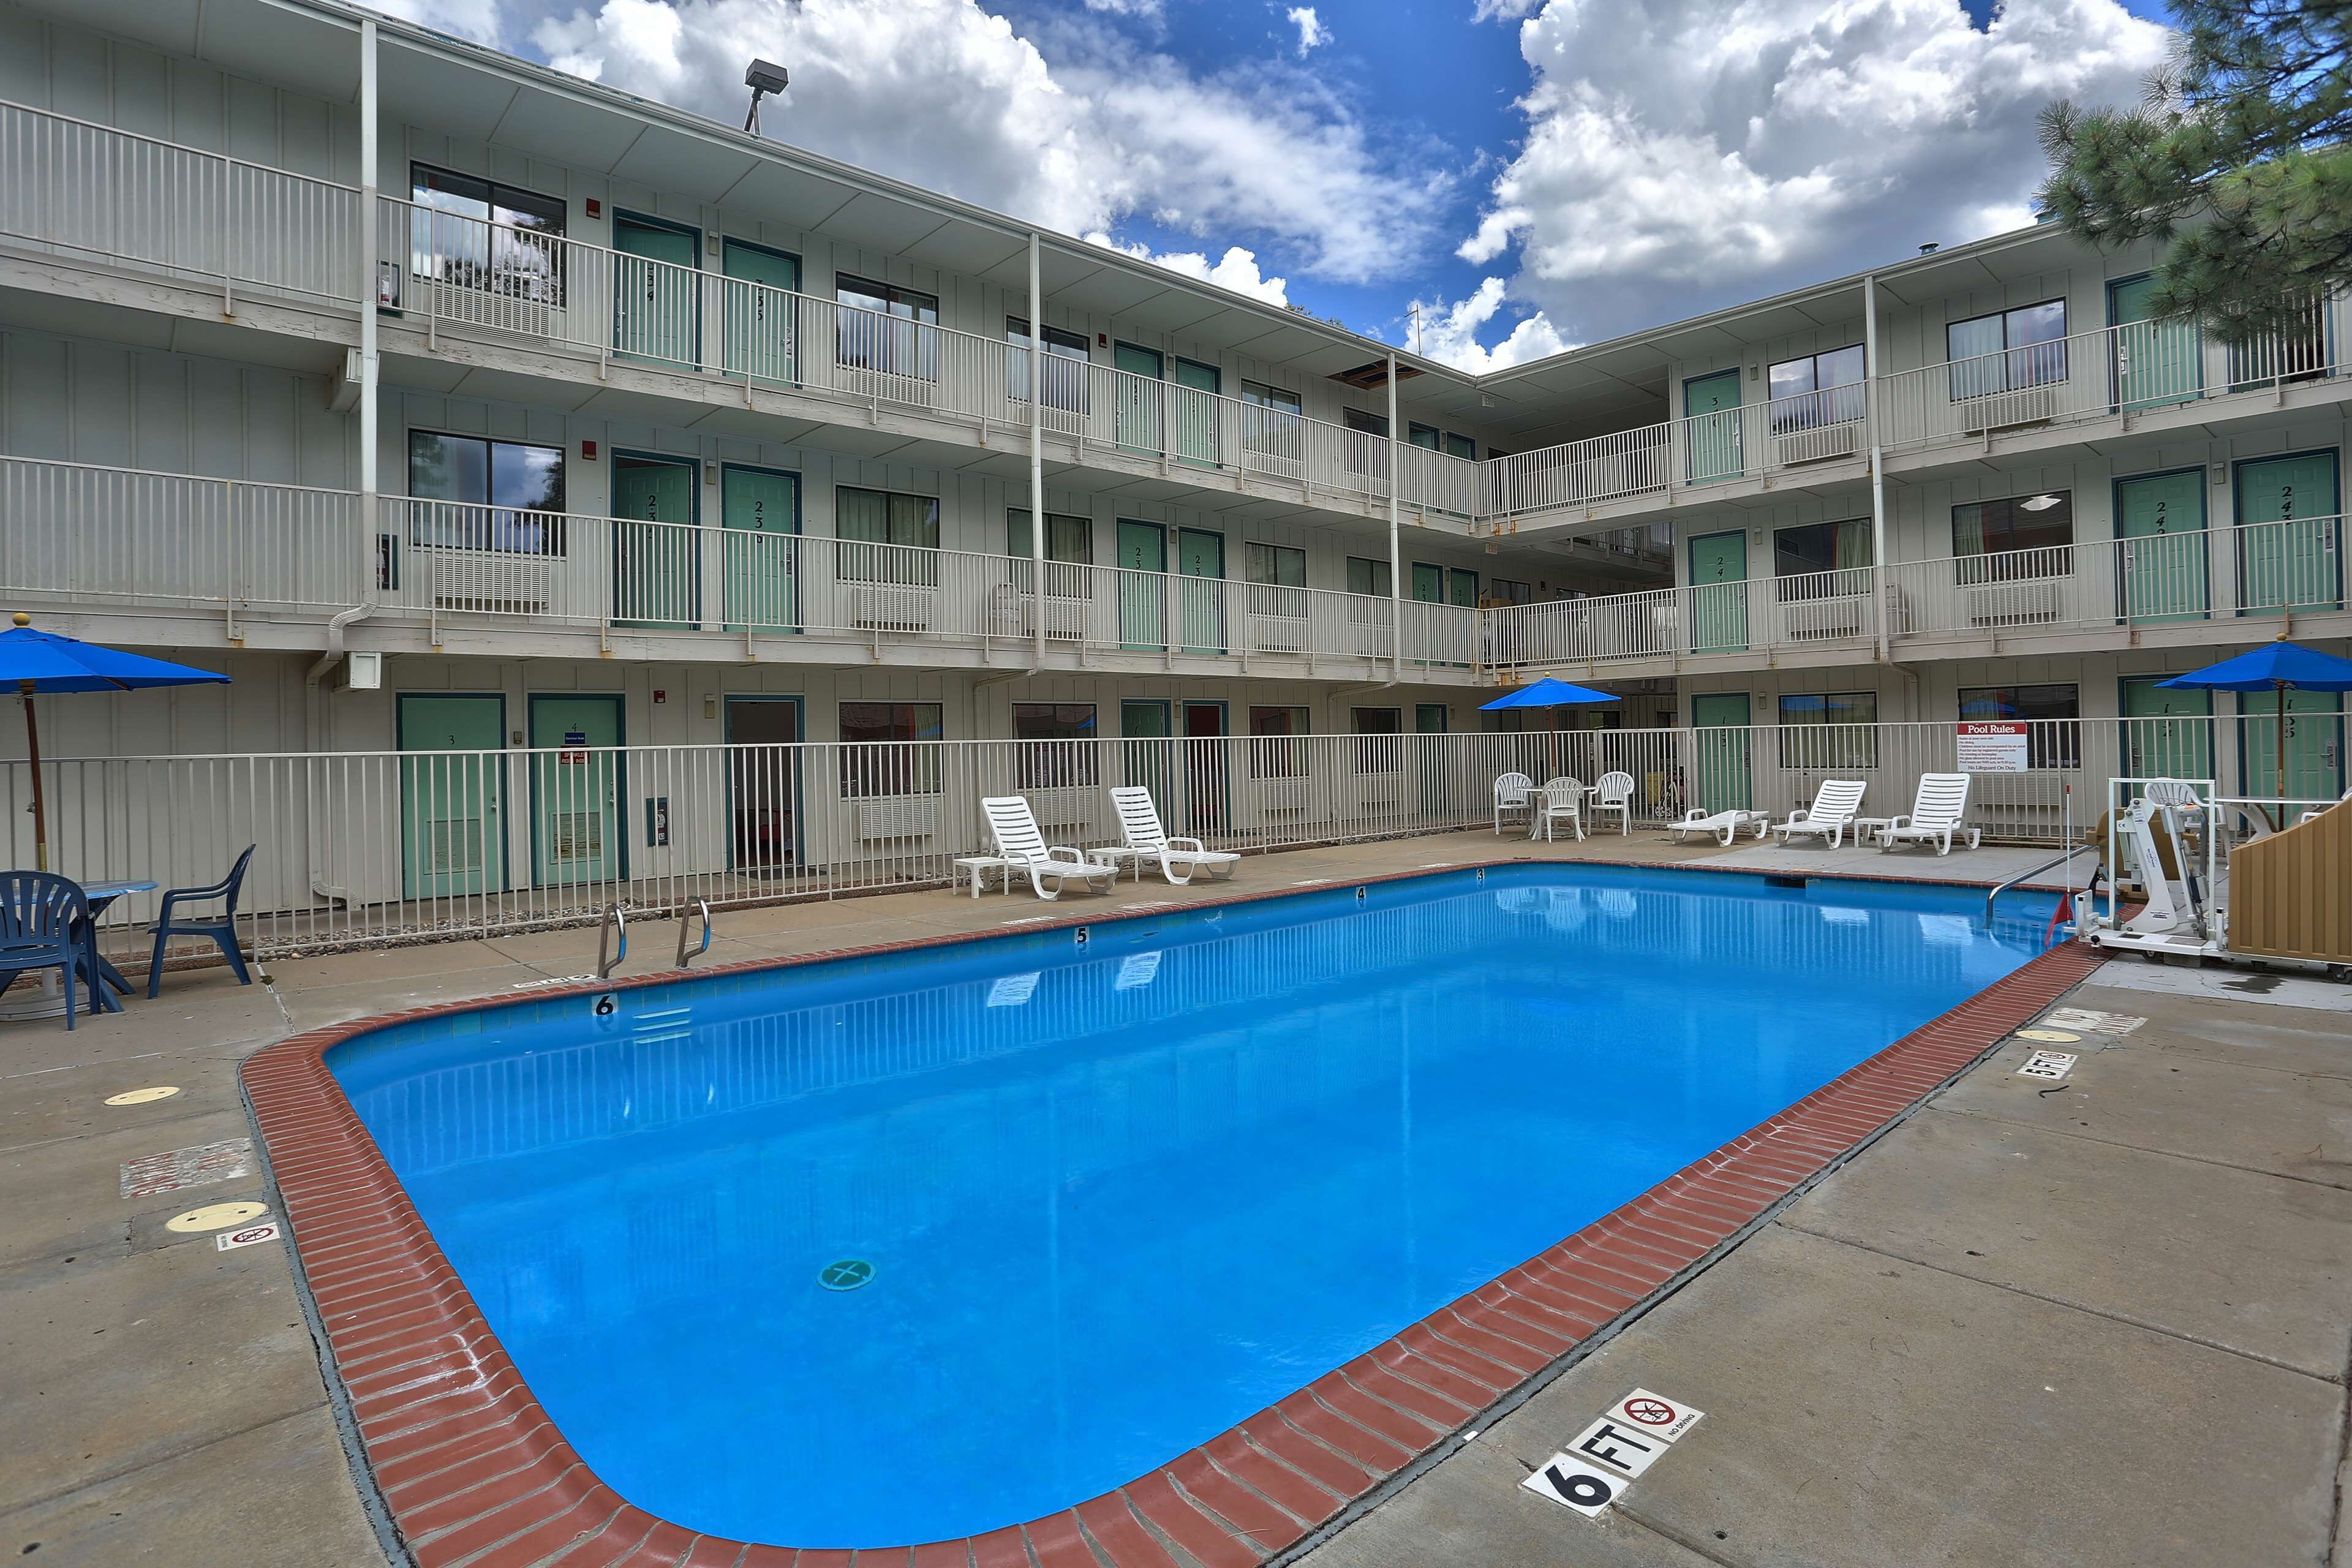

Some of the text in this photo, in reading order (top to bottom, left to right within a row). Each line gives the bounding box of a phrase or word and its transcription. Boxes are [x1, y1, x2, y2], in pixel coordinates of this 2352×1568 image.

[1968, 725, 2016, 734] Pool Rules
[448, 735, 455, 745] 3
[1477, 869, 1483, 880] 3
[1357, 888, 1365, 899] 4
[1077, 928, 1087, 943] 5
[595, 995, 614, 1015] 6
[2032, 1059, 2066, 1069] FT
[1668, 1414, 1695, 1436] NO DIVING
[1544, 1424, 1652, 1507] 6 FT
